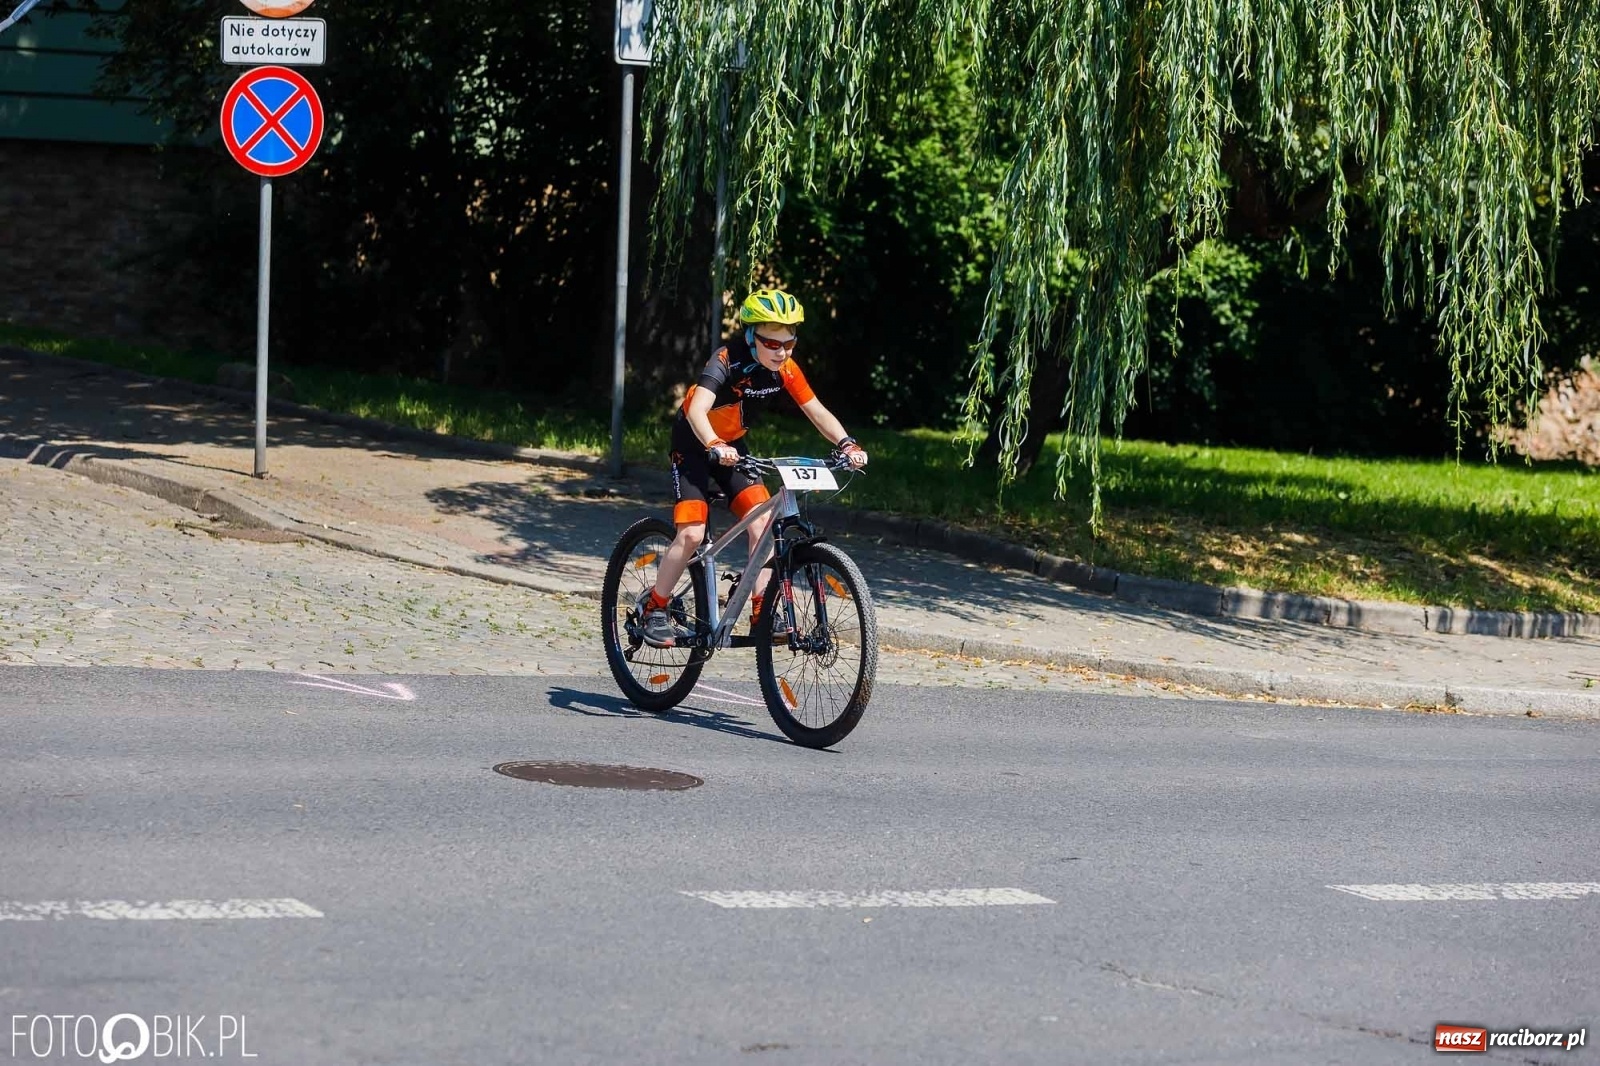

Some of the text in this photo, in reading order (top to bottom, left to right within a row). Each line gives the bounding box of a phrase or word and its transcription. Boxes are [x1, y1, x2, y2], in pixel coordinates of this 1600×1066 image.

[230, 23, 317, 42] Nie dotyczy
[231, 43, 311, 57] autokarów
[791, 468, 817, 480] 137
